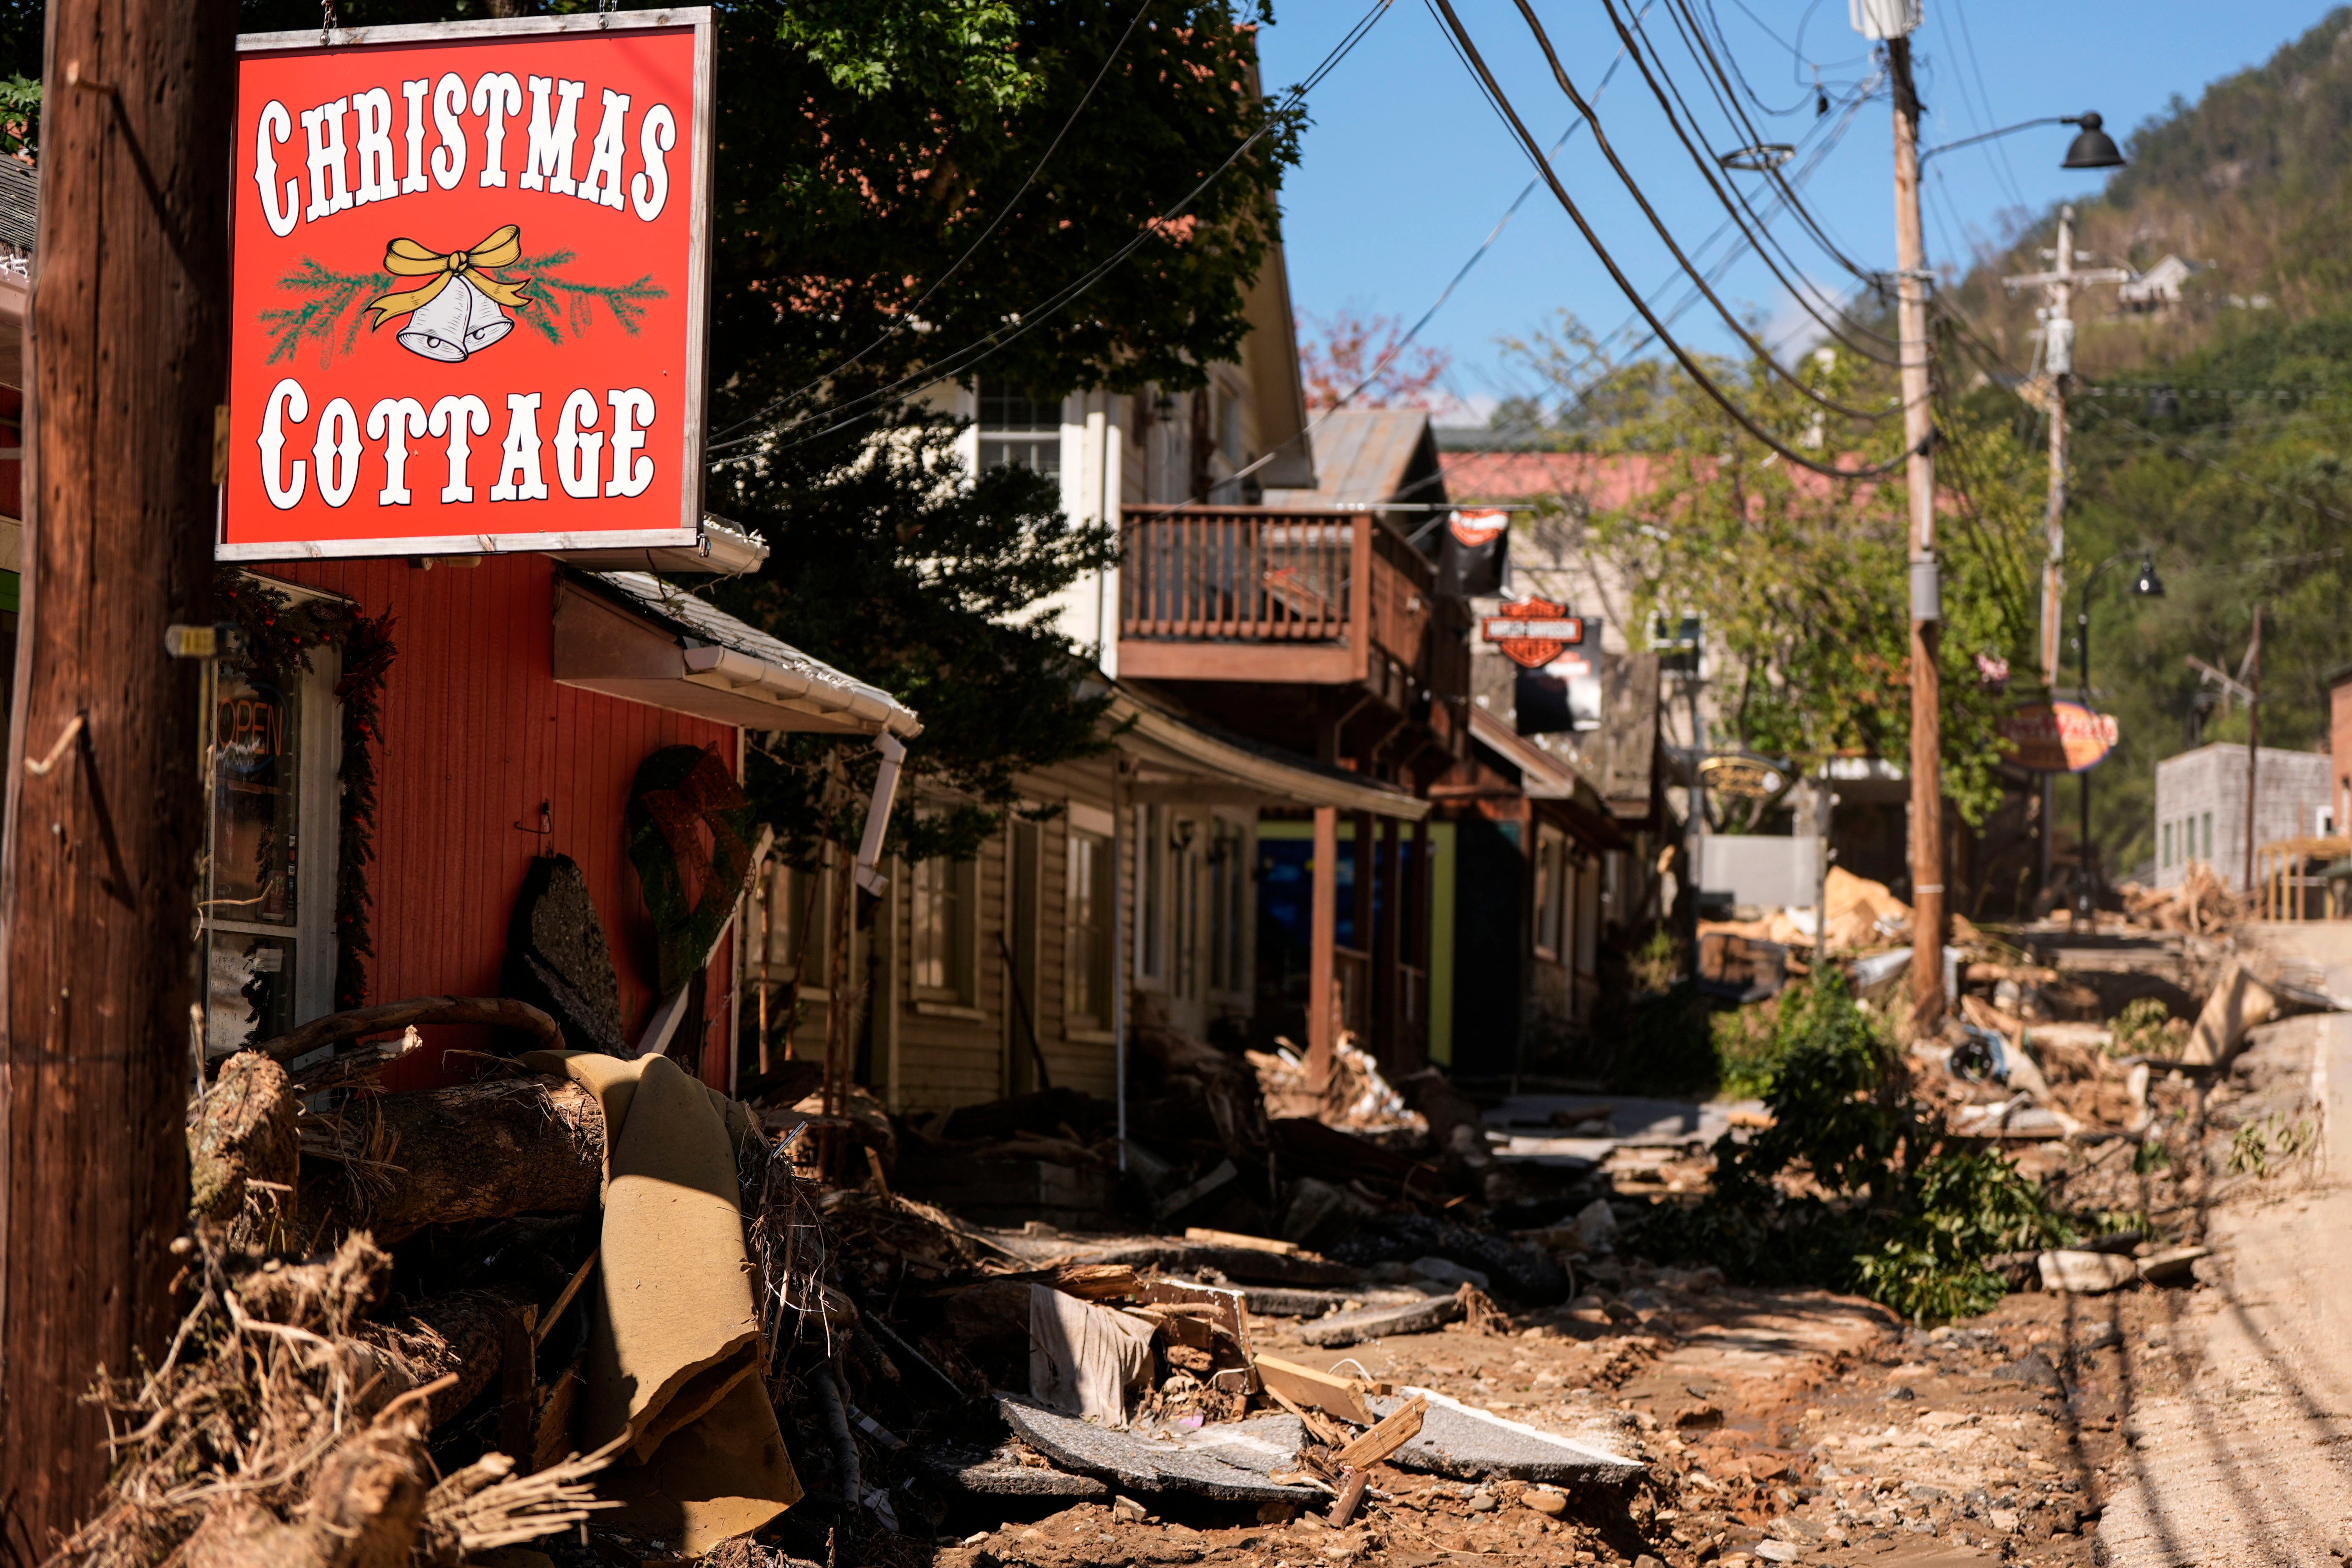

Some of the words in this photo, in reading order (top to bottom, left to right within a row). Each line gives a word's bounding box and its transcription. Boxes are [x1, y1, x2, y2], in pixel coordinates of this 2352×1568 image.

[254, 71, 676, 238] CHRISTMAS
[257, 377, 656, 511] COTTAGE
[217, 696, 284, 757] OPEN
